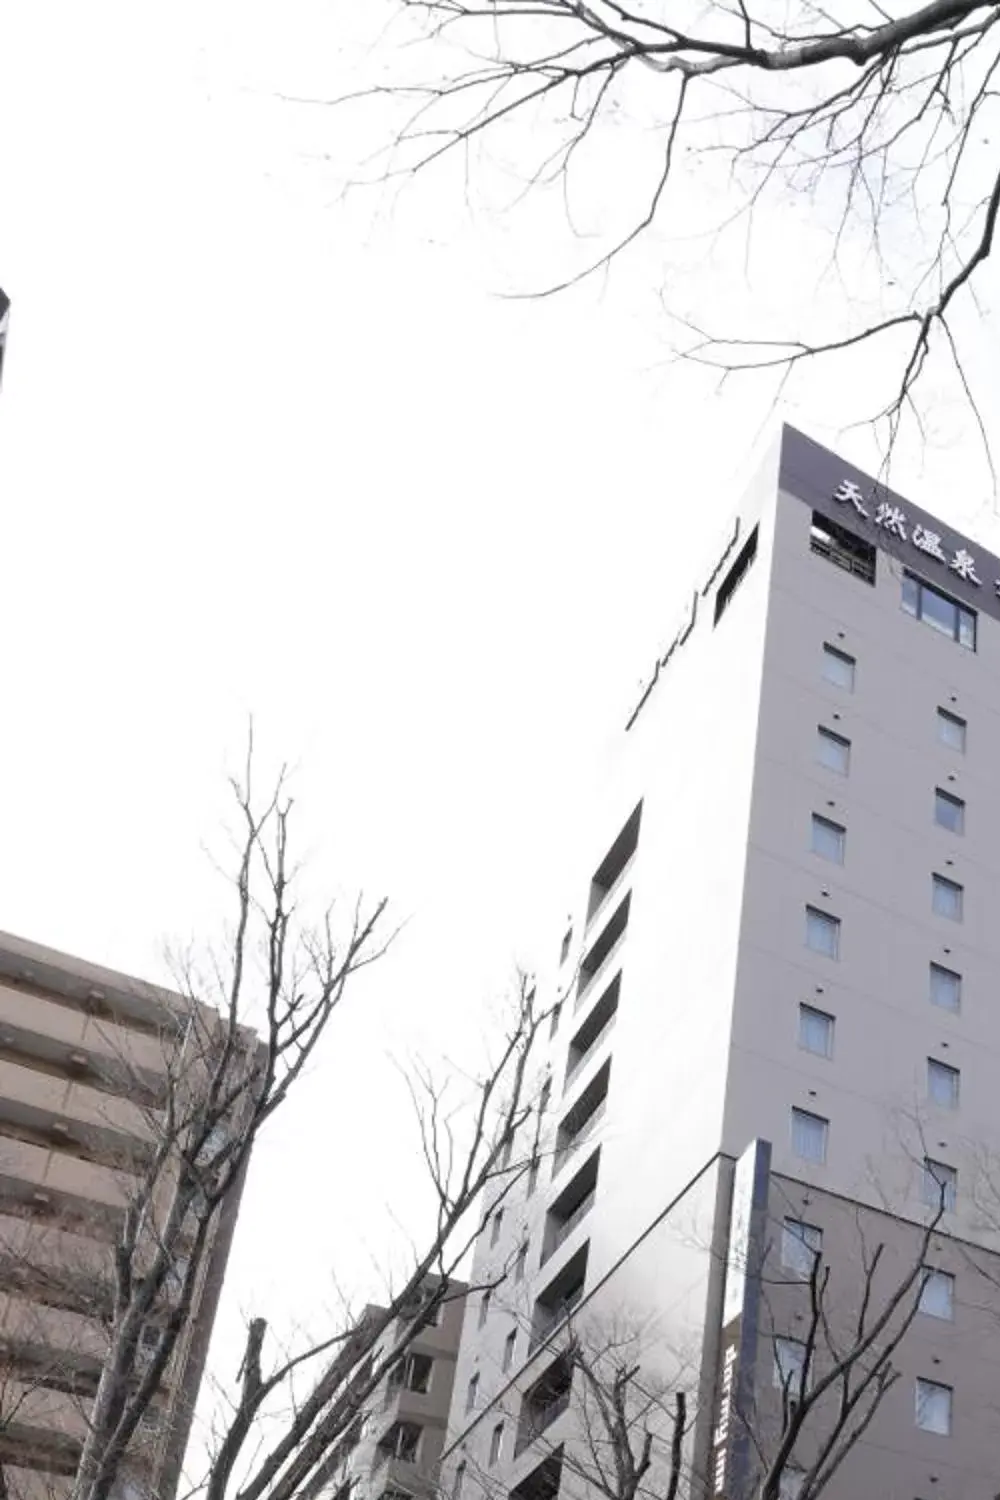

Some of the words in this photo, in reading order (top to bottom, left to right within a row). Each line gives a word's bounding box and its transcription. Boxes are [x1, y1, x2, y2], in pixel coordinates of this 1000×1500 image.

[832, 479, 983, 587] 天然温泉
[714, 1344, 738, 1447] dormy
[714, 1447, 727, 1495] inn
